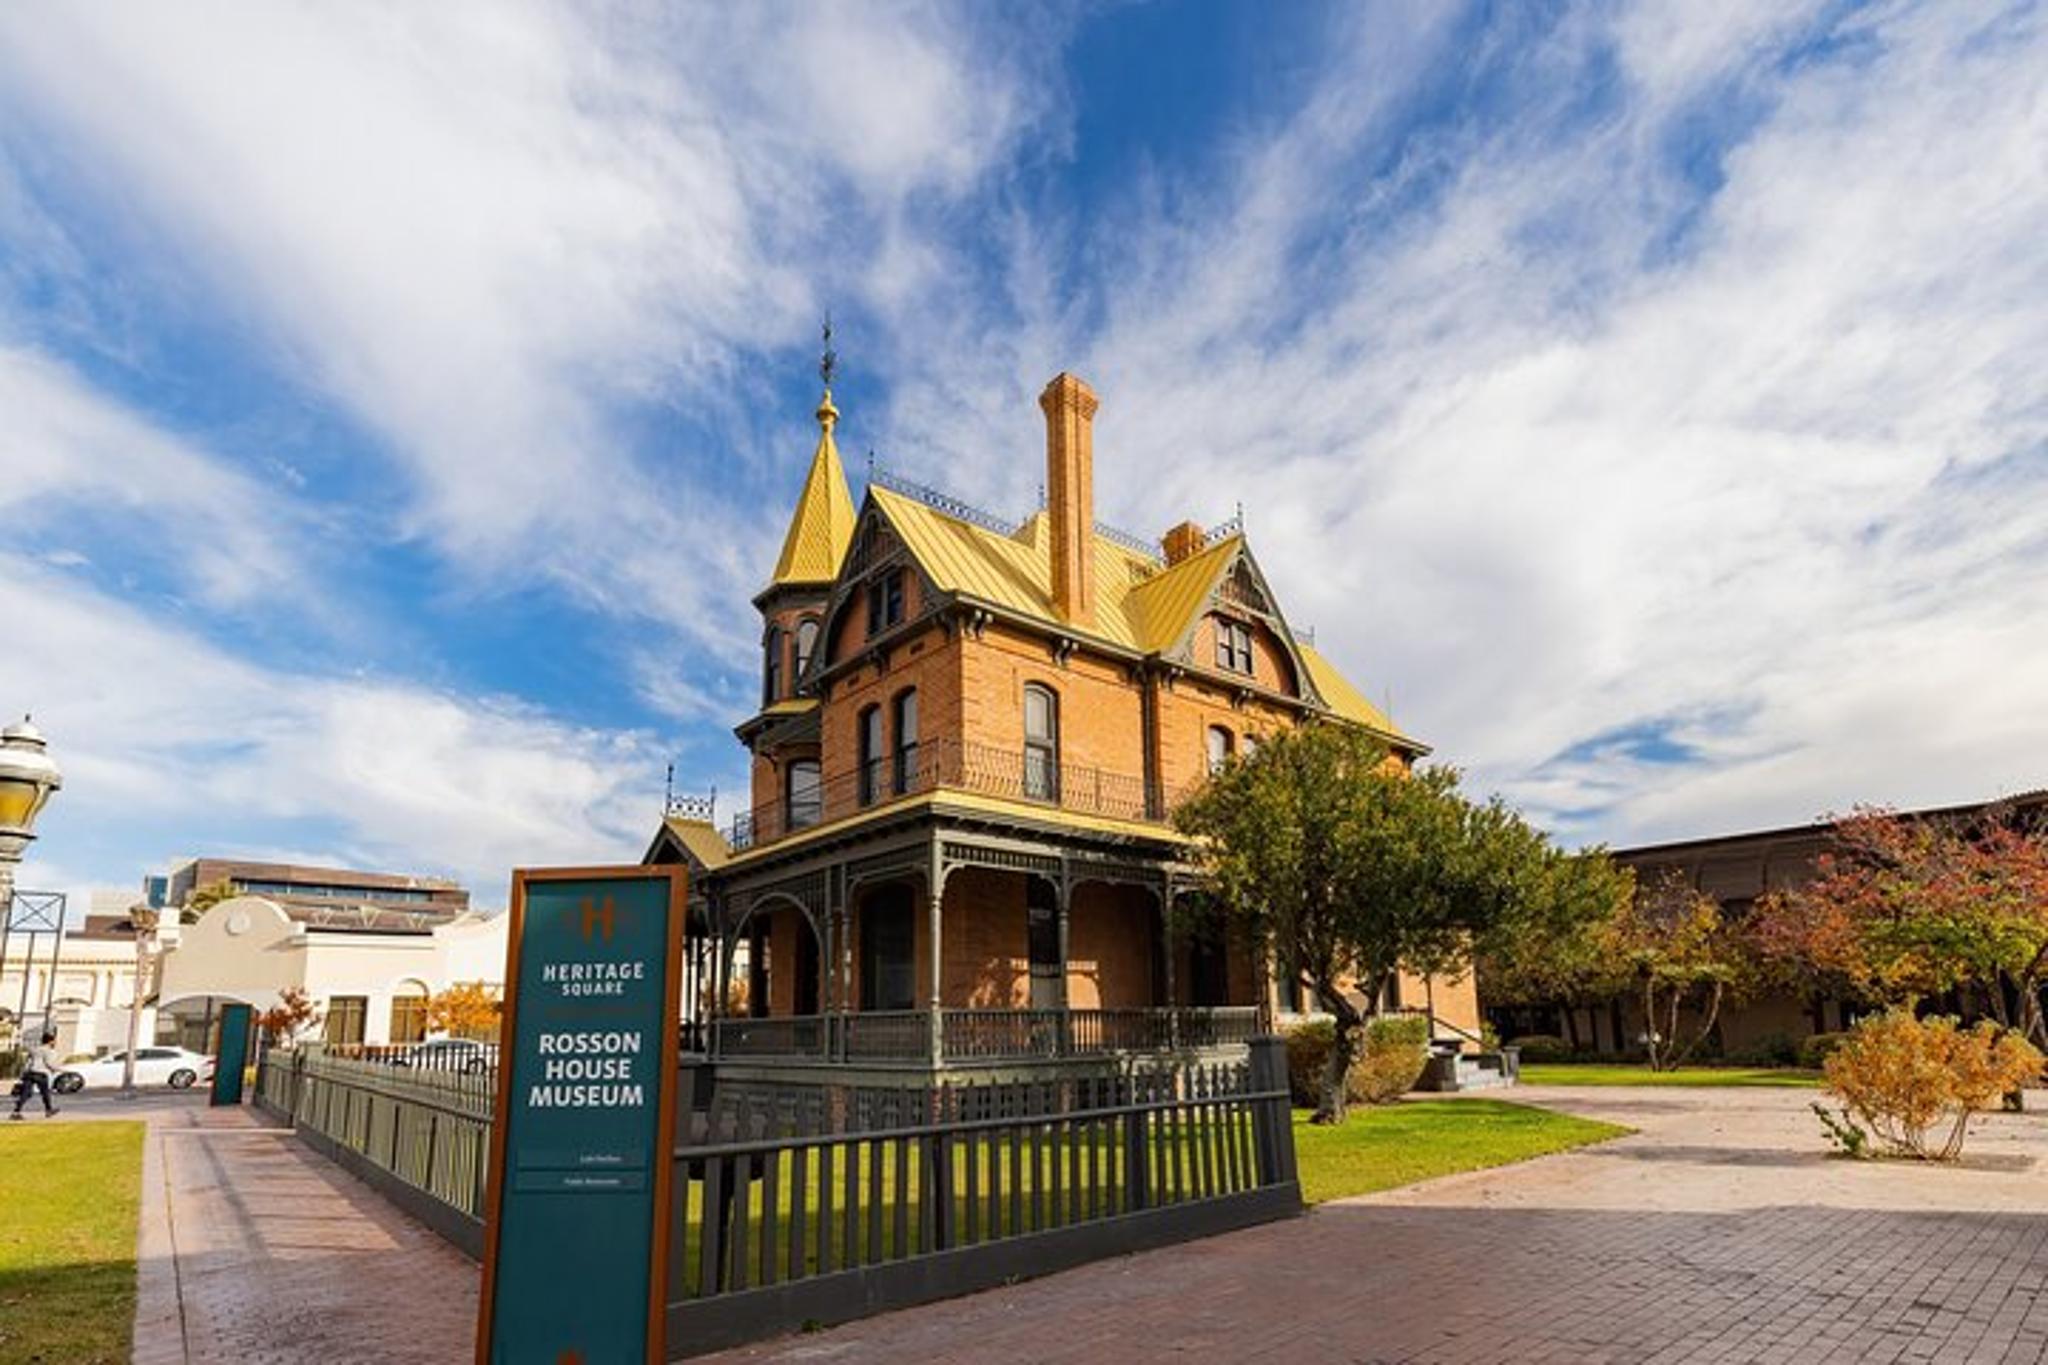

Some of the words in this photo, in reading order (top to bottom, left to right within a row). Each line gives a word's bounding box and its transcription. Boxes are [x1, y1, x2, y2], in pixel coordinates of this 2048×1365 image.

[581, 895, 614, 944] H
[543, 961, 644, 981] HERITAGE
[562, 981, 624, 996] SQUARE
[539, 1031, 641, 1054] ROSSON
[545, 1058, 631, 1080] HOUSE
[528, 1084, 643, 1107] MUSEUM
